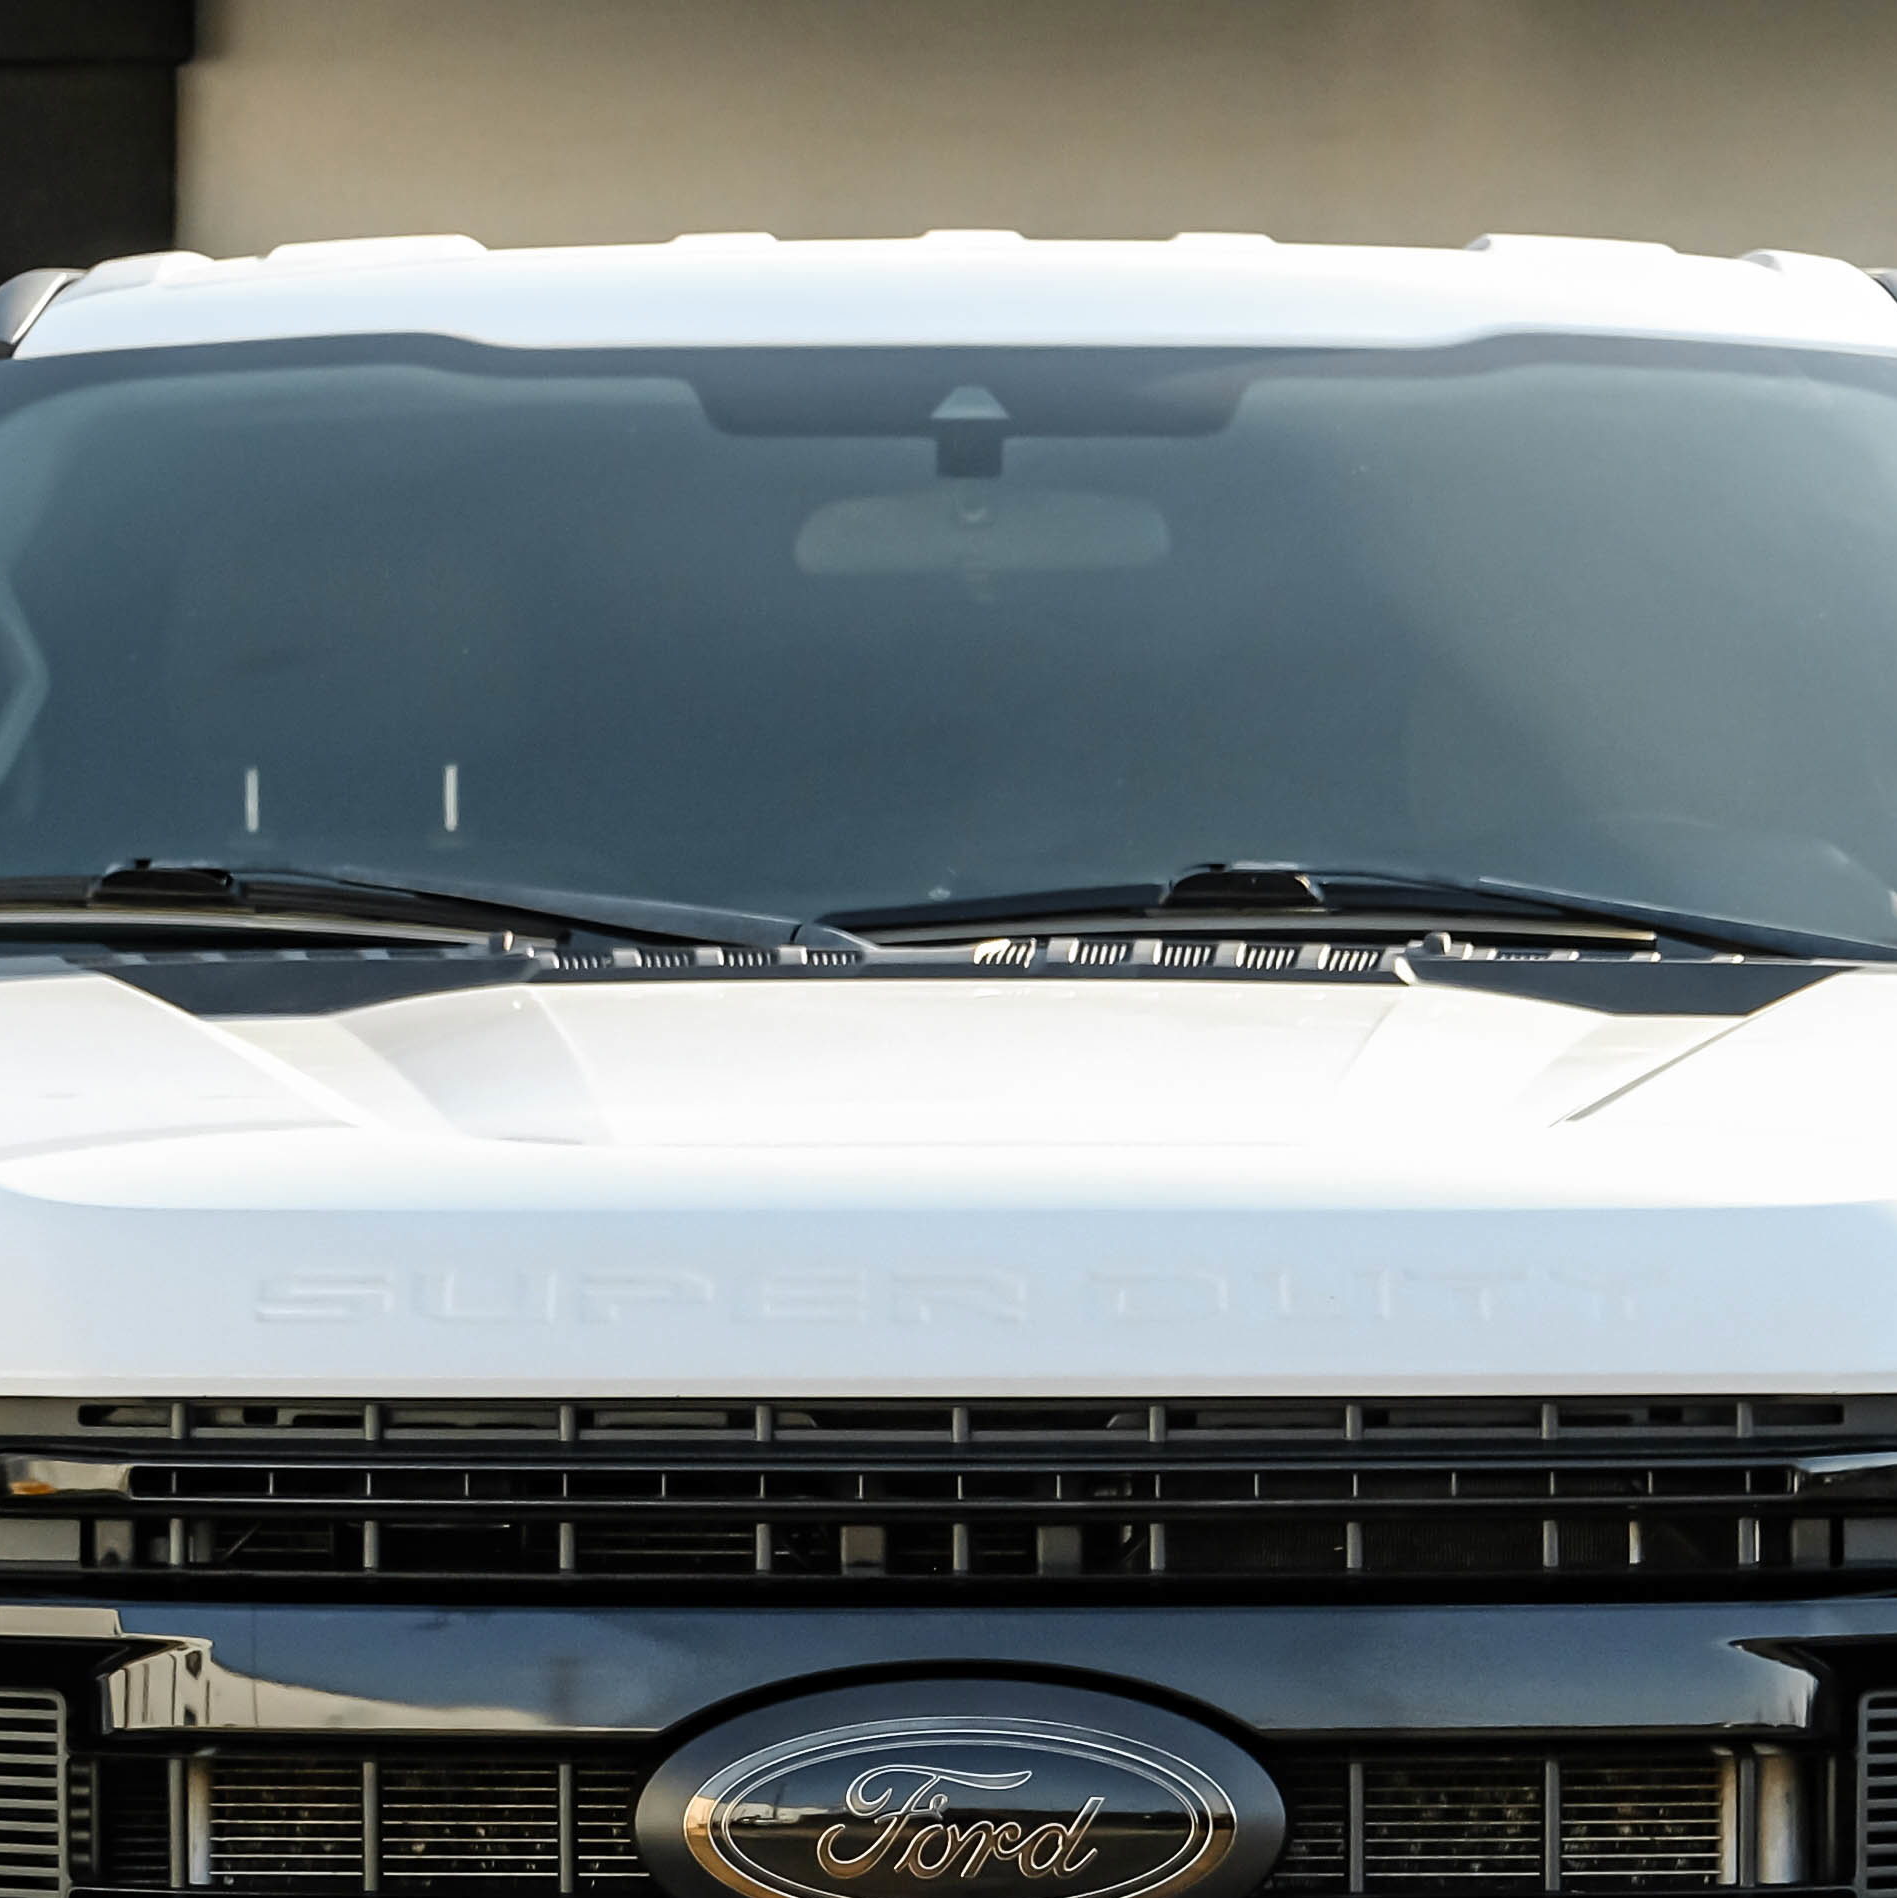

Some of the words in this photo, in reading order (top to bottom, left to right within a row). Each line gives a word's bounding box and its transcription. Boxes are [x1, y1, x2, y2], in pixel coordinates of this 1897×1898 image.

[252, 1268, 1031, 1325] SUPER
[1085, 1266, 1668, 1325] DUTY
[815, 1763, 1105, 1881] Ford
